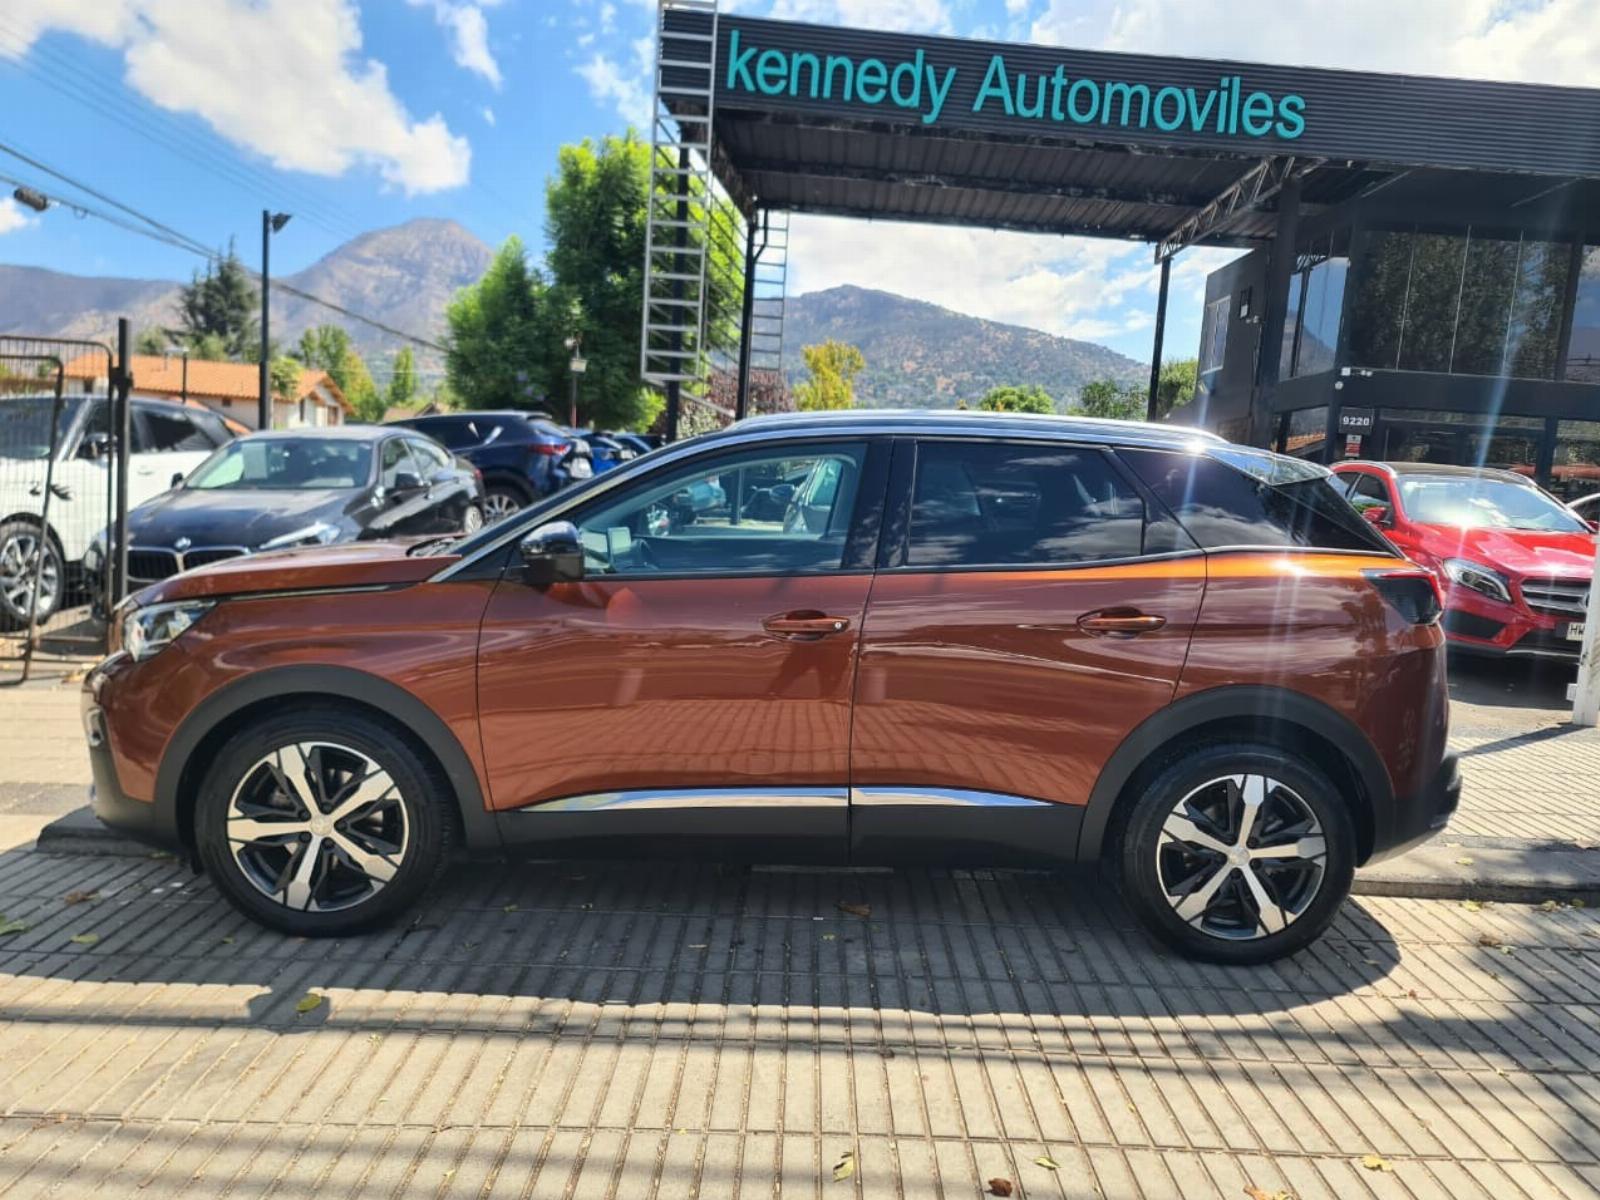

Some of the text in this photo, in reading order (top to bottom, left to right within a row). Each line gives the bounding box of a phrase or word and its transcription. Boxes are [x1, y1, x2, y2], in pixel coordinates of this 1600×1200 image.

[726, 29, 1307, 140] kennedy Automoviles
[1343, 416, 1370, 426] 9220
